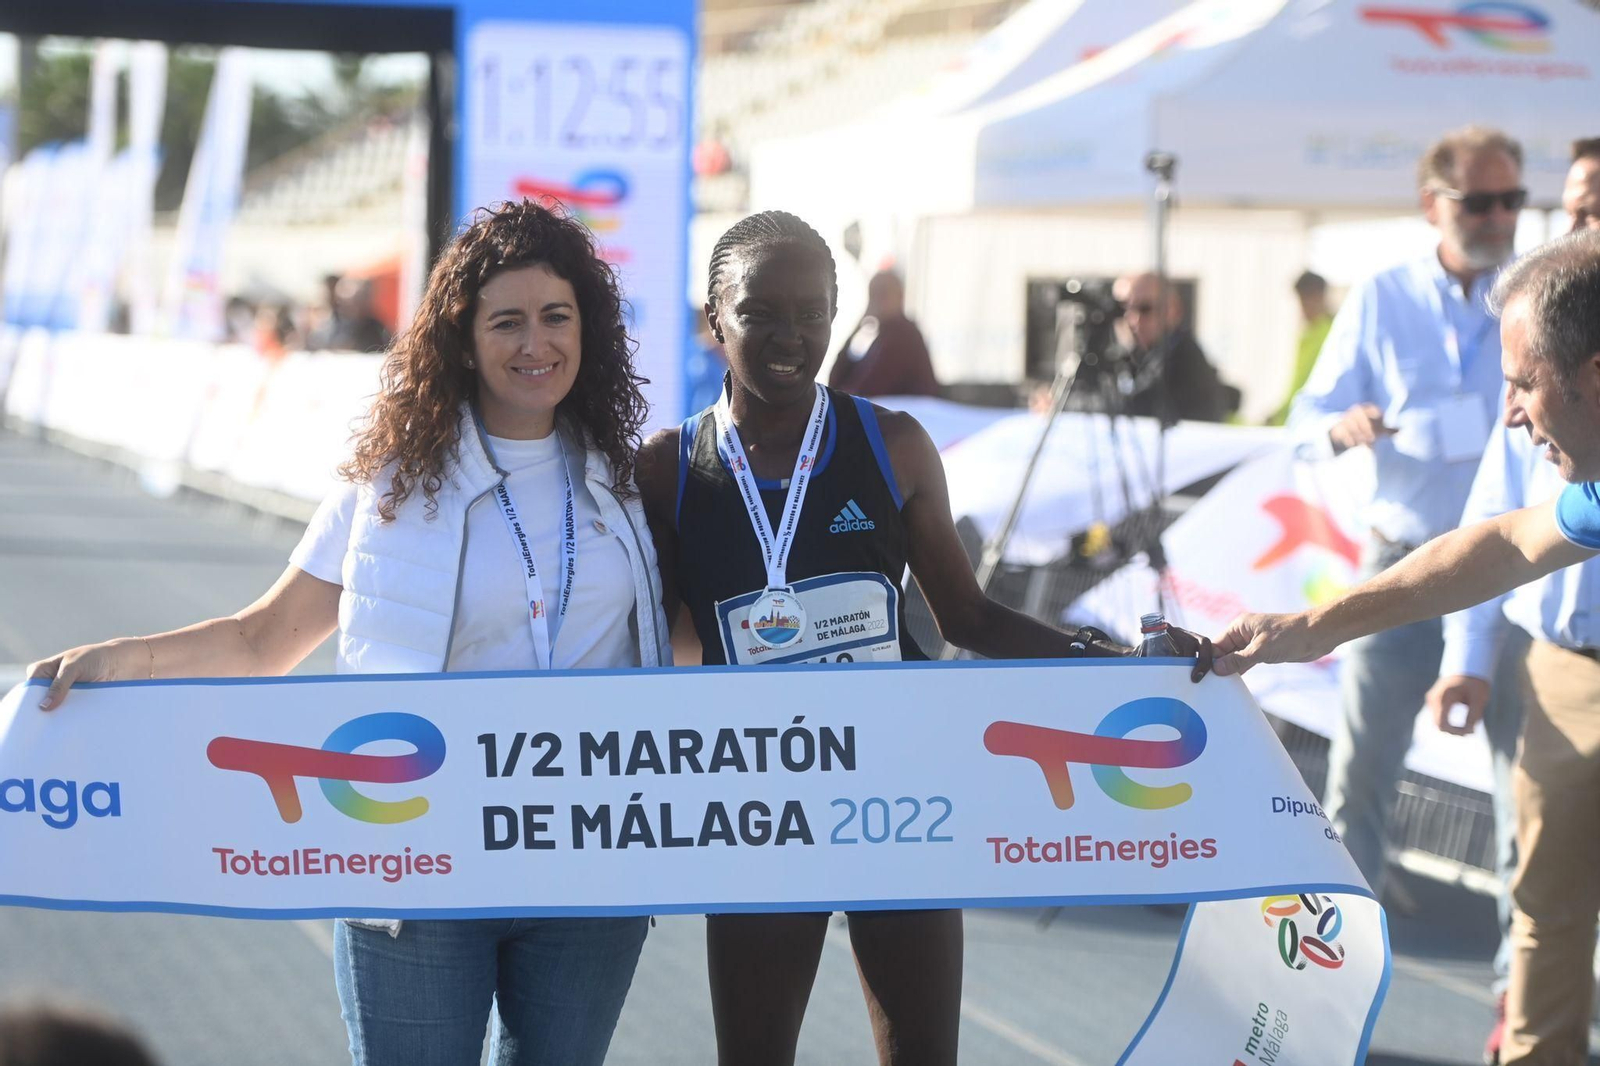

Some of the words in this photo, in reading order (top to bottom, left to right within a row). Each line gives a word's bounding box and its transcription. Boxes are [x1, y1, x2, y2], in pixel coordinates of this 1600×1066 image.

[505, 507, 517, 521] 1/2
[829, 519, 875, 533] adidas
[512, 522, 536, 579] TotalEnergies
[566, 541, 575, 554] 1/2
[560, 557, 575, 616] TotalEnergies
[814, 619, 829, 630] 1/2
[829, 610, 871, 627] MARATÓN
[817, 631, 830, 641] DE
[830, 623, 866, 638] MÁLAGA
[867, 618, 885, 631] 2022
[477, 732, 564, 778] 1/2
[579, 715, 856, 776] MARATÓN
[482, 805, 557, 851] DE
[571, 792, 815, 850] MÁLAGA
[829, 795, 954, 845] 2022
[212, 847, 452, 883] TotalEnergies
[986, 832, 1217, 869] TotalEnergies
[1244, 1002, 1269, 1056] metro
[1258, 1009, 1289, 1066] Málaga
